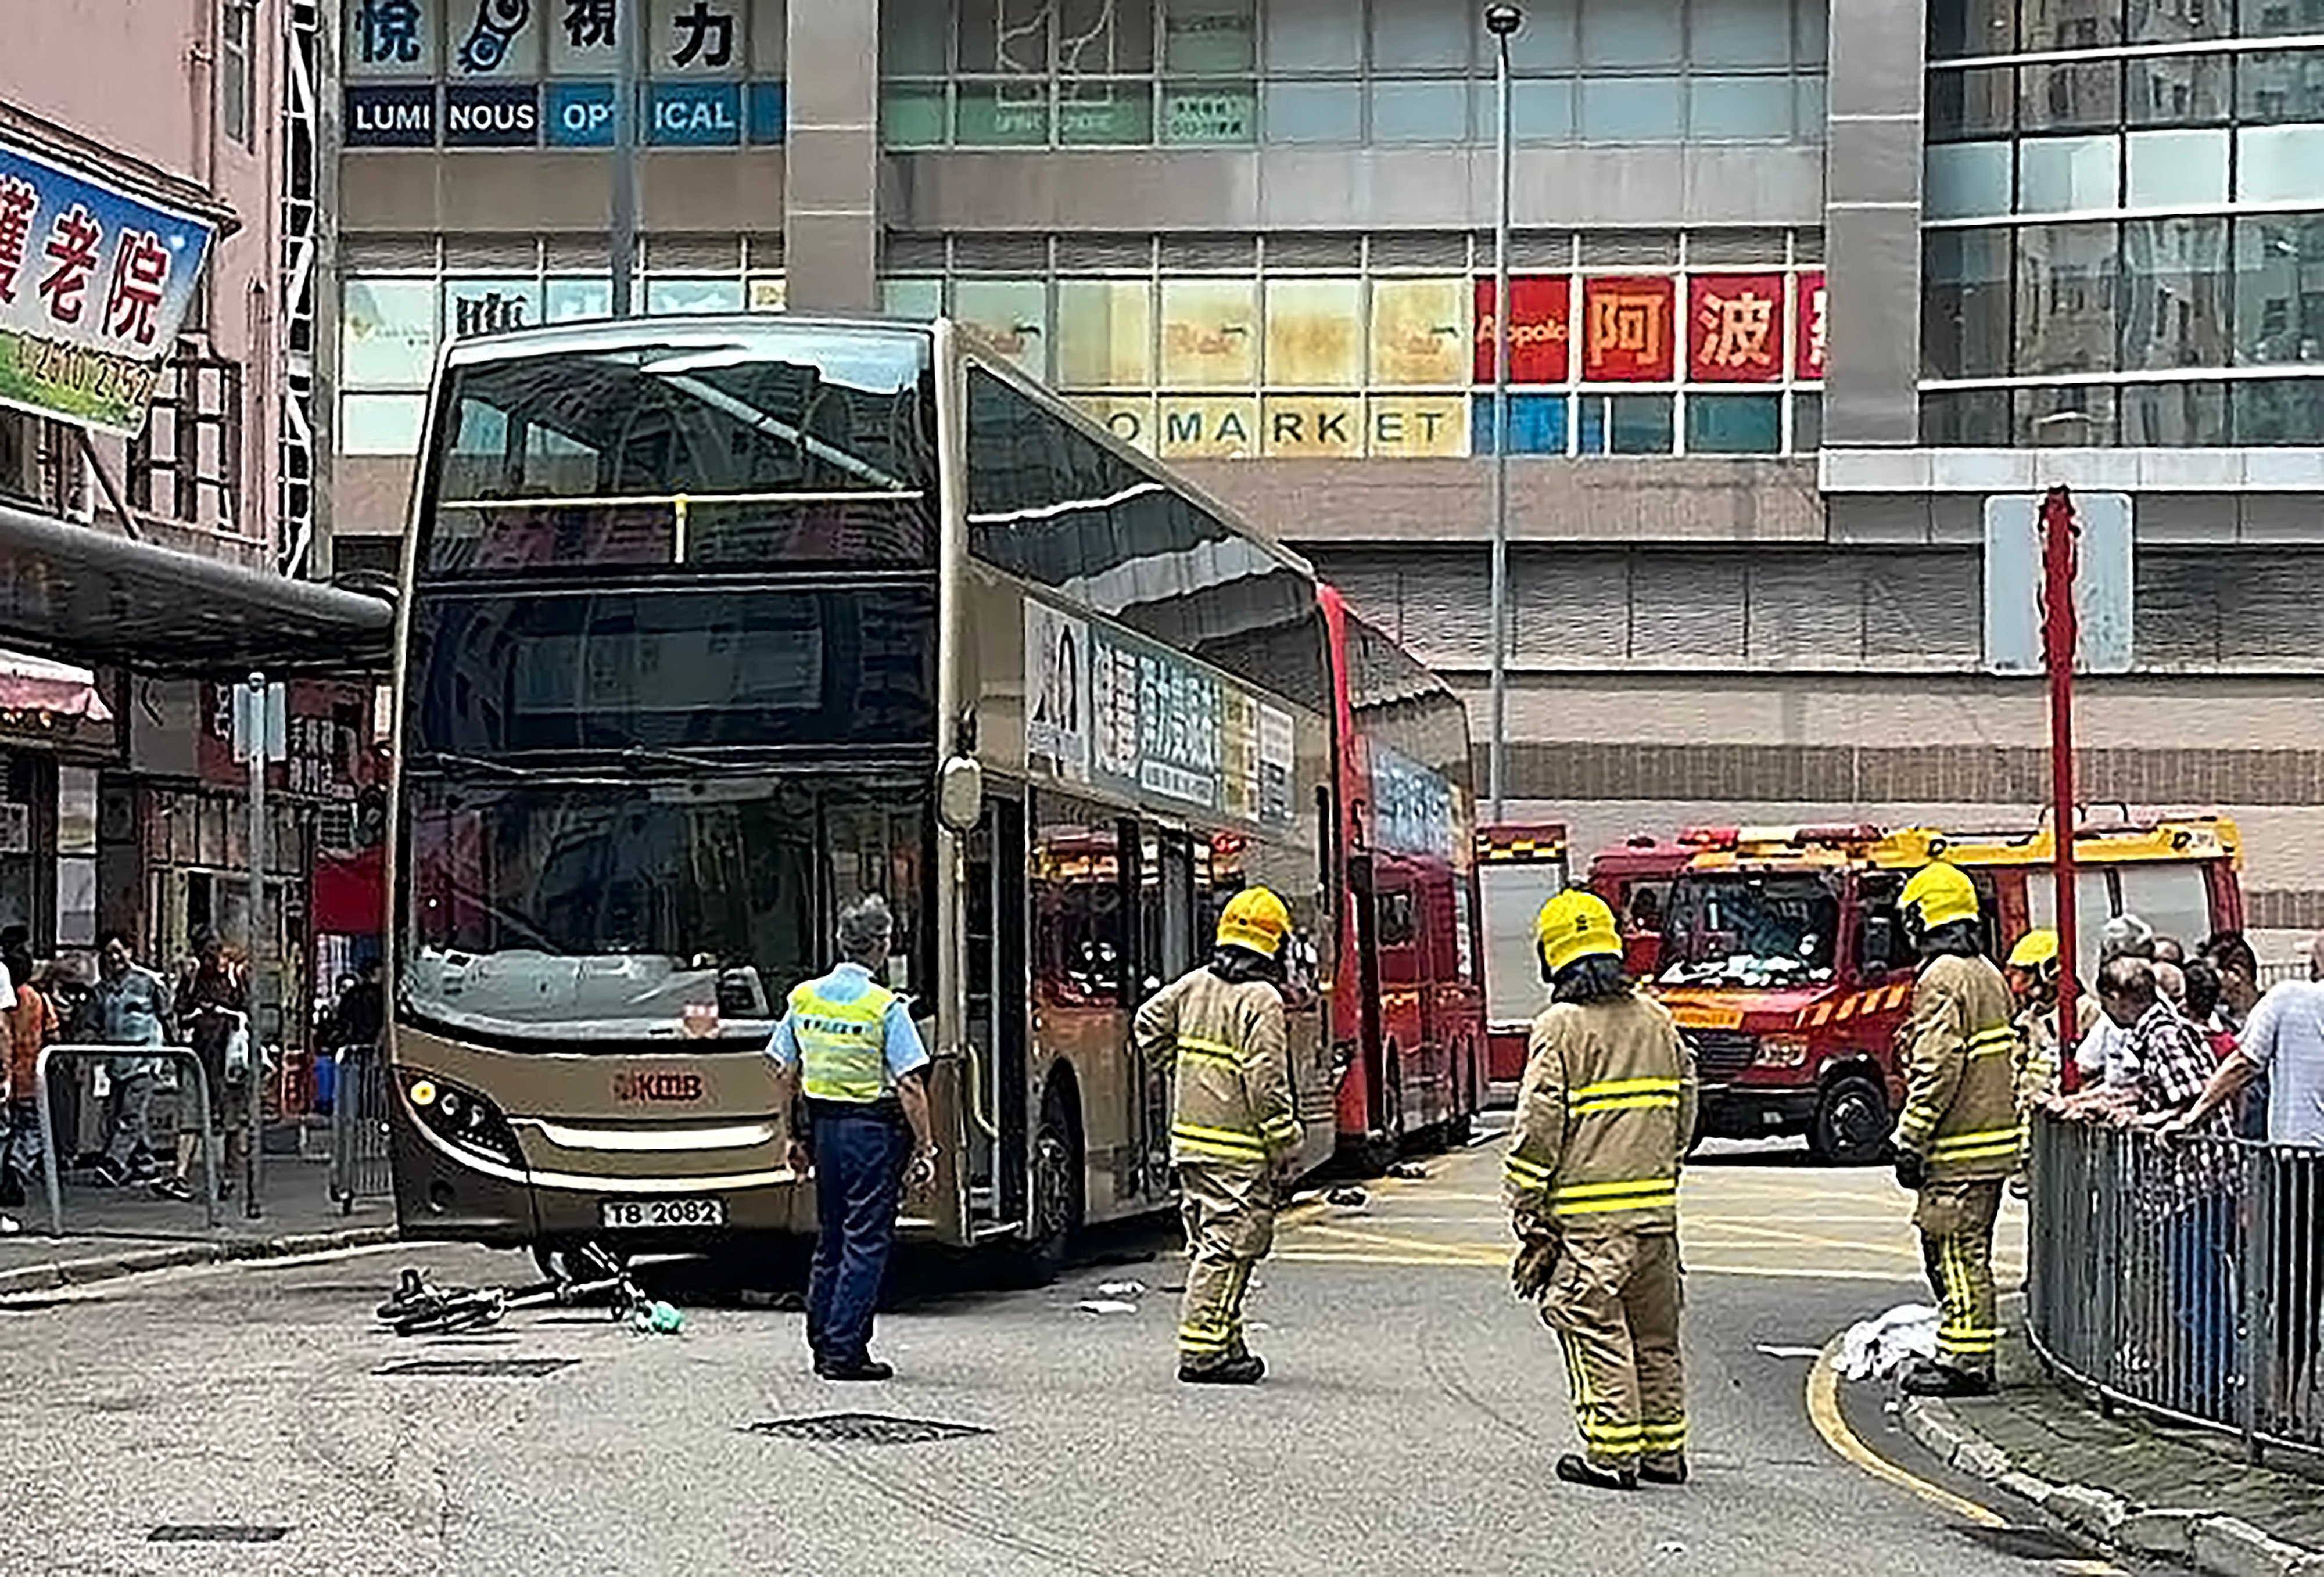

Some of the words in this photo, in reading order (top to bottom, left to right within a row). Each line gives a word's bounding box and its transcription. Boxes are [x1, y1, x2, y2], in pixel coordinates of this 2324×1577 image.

[1589, 290, 1826, 365] 阿波
[638, 1075, 702, 1101] KMB
[652, 1201, 716, 1223] 2082
